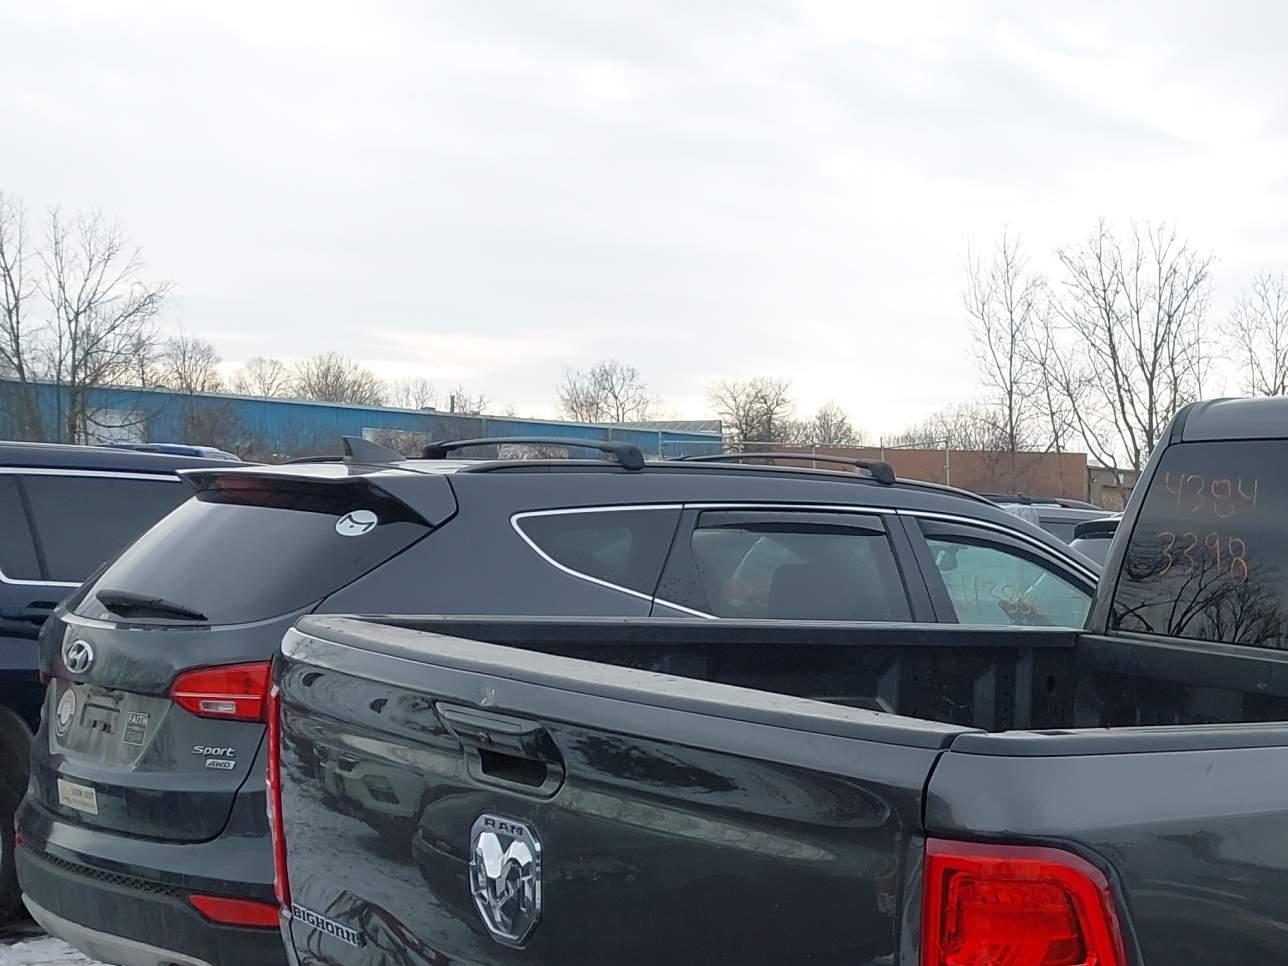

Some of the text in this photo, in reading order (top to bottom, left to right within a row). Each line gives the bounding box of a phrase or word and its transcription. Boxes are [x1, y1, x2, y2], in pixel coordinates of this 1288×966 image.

[1157, 531, 1248, 585] 3398
[192, 745, 236, 757] Sport
[207, 760, 232, 768] AWD
[483, 818, 524, 836] RAM
